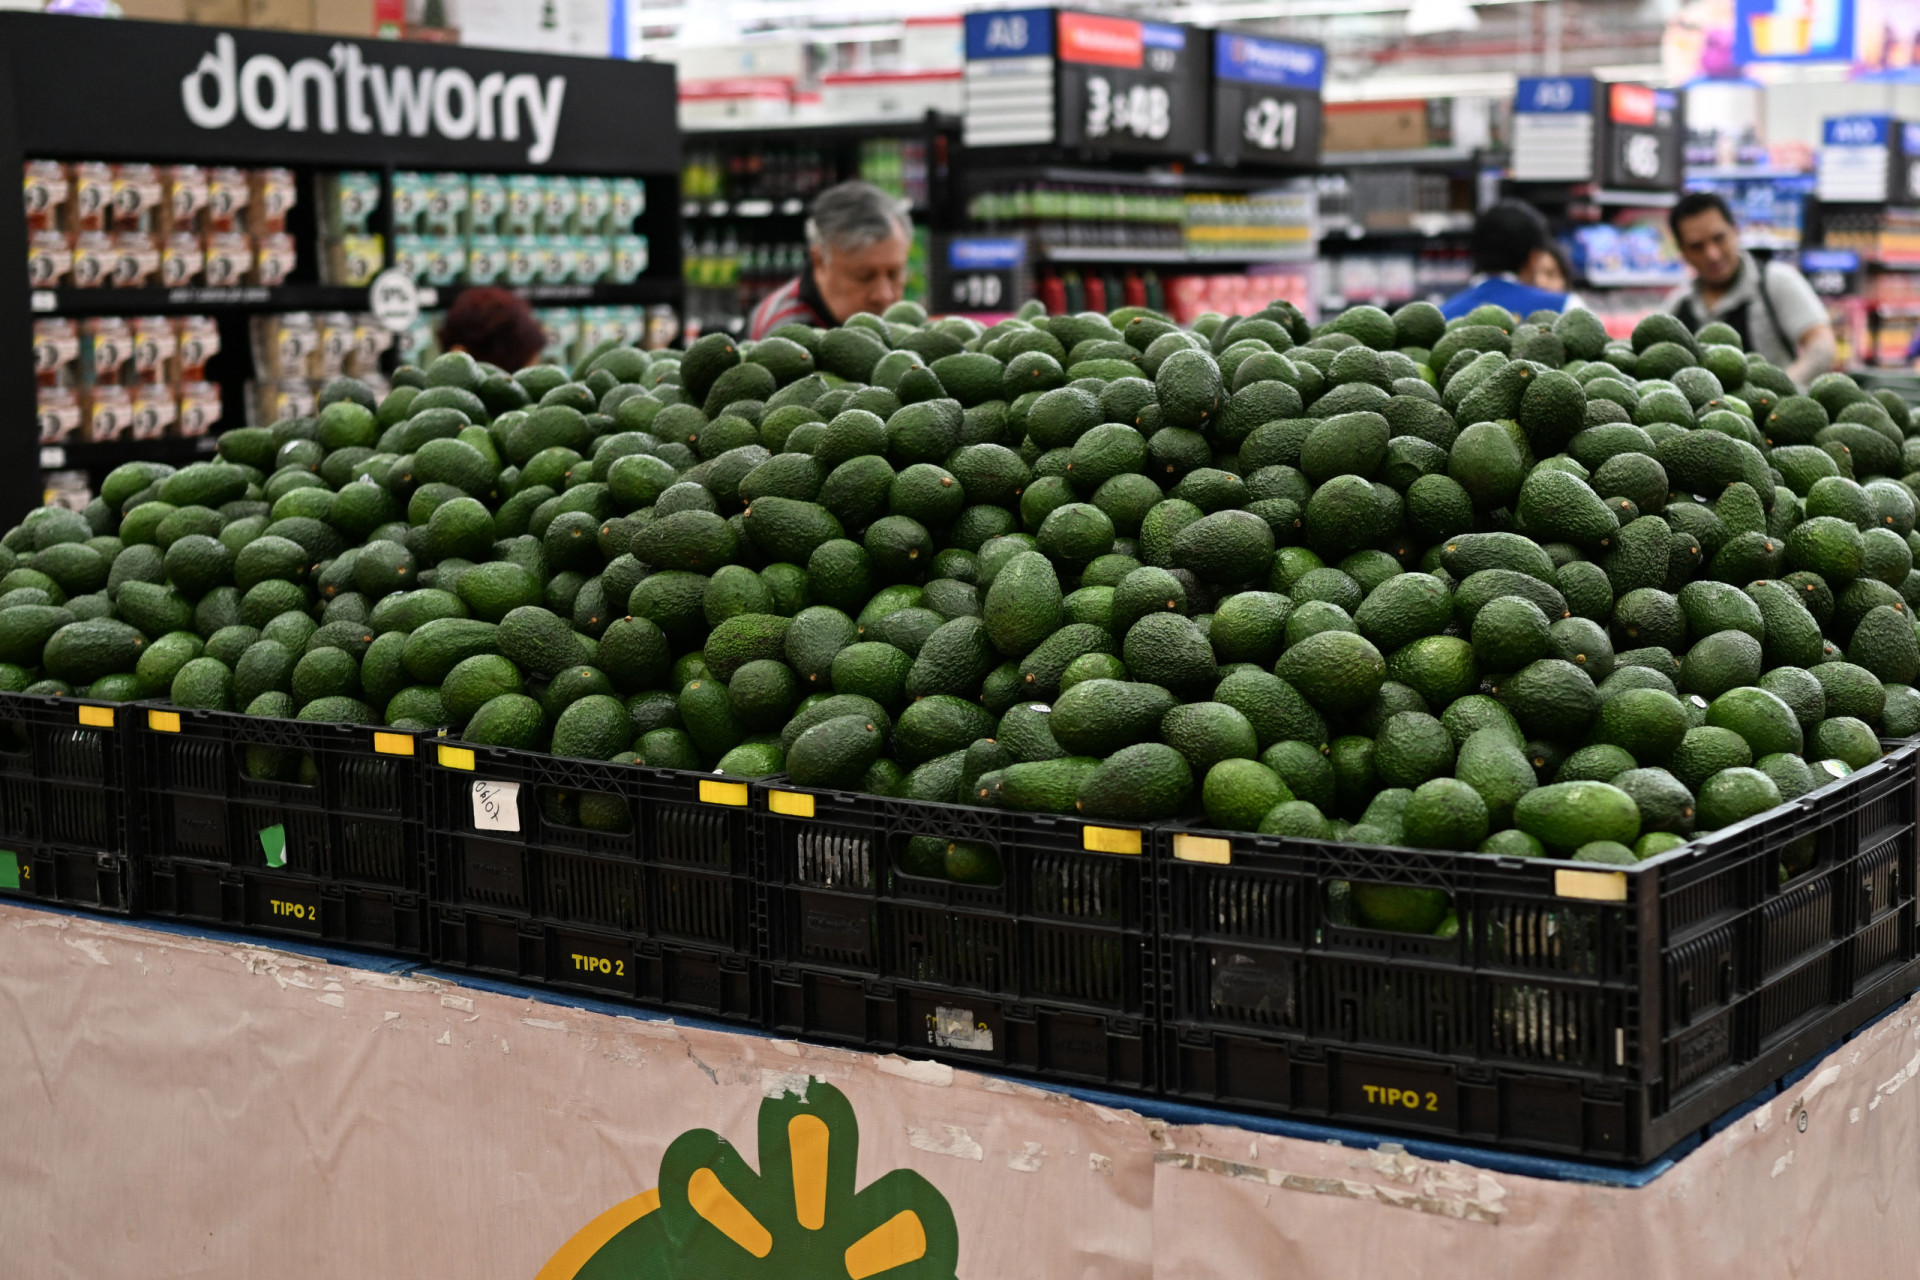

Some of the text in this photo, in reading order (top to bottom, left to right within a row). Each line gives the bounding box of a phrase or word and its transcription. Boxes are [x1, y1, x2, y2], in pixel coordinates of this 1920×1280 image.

[23, 864, 31, 880] 2
[270, 899, 316, 921] TIPO 2
[571, 953, 625, 977] TIPO 2
[1362, 1084, 1439, 1112] TIPO 2
